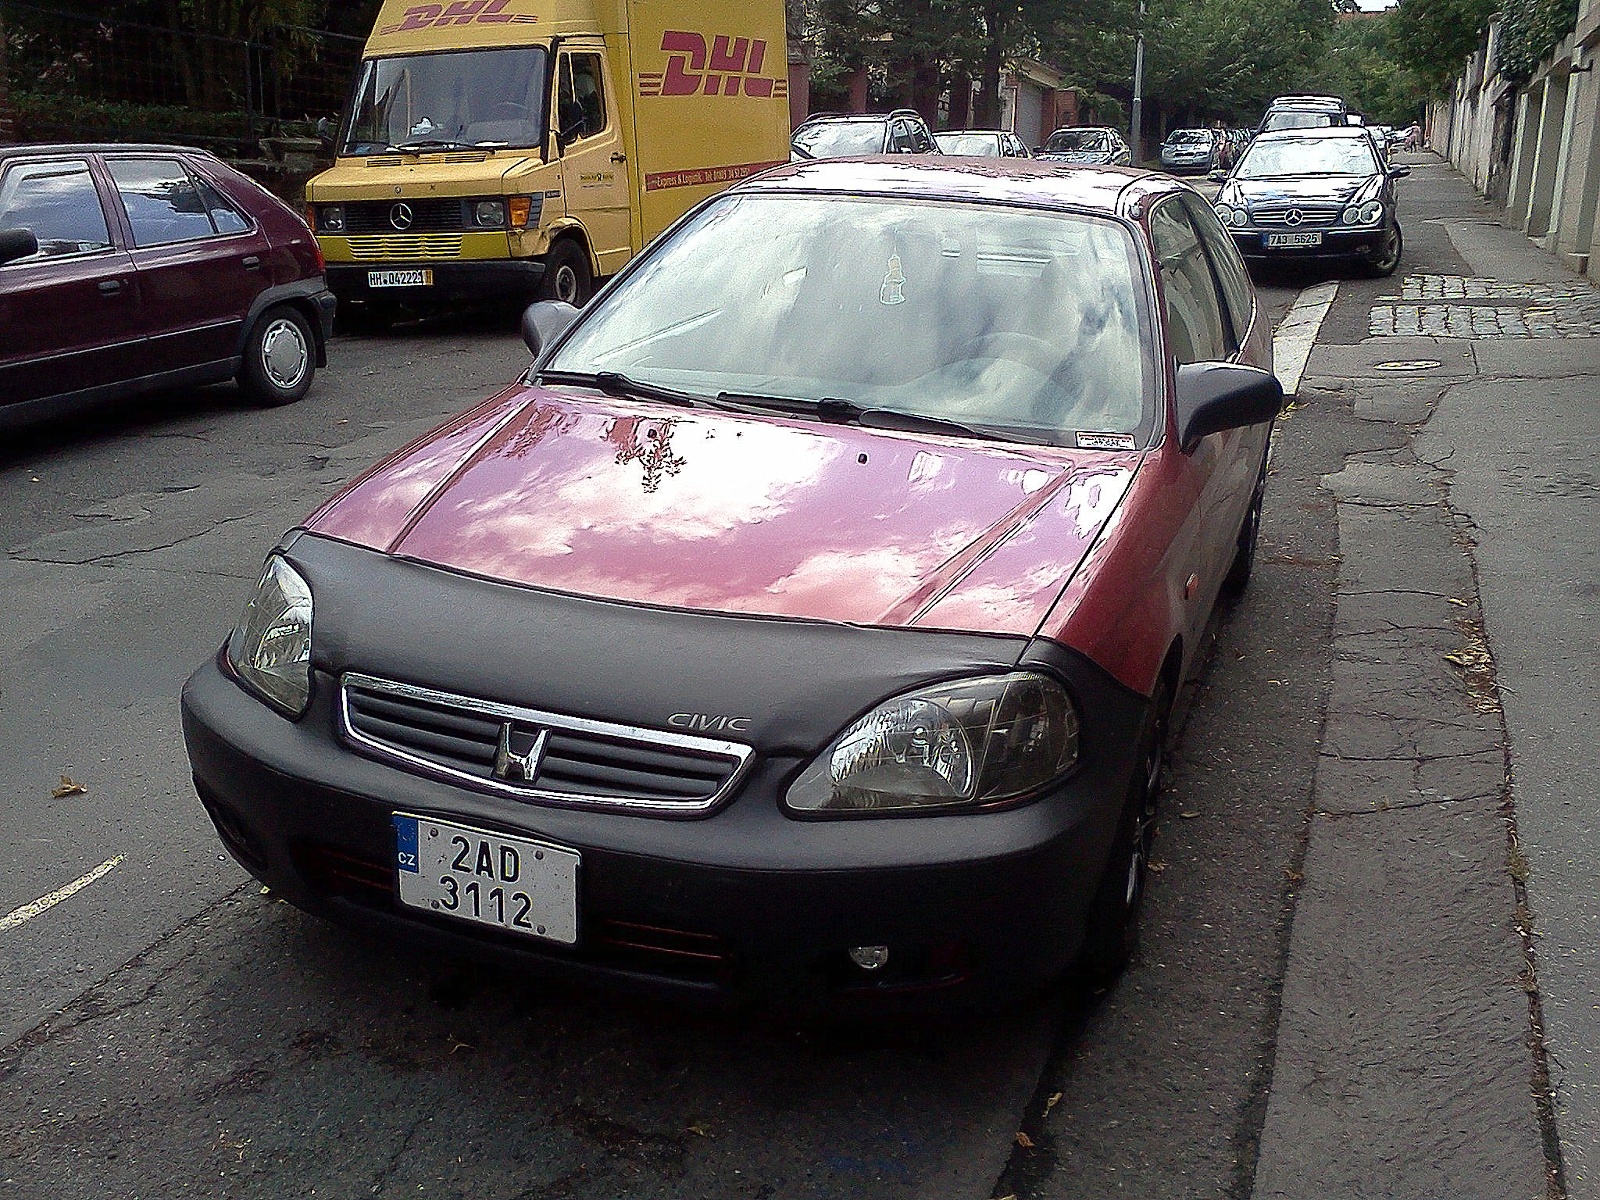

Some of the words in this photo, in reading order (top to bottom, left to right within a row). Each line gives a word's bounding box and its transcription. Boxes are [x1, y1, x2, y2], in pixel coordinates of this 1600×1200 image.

[400, 0, 513, 31] DHL
[661, 31, 774, 98] DHL
[1294, 234, 1318, 244] 5625
[667, 712, 752, 731] CIVIC
[398, 851, 416, 866] CZ
[451, 835, 520, 883] 2AD
[440, 875, 532, 928] 3112
